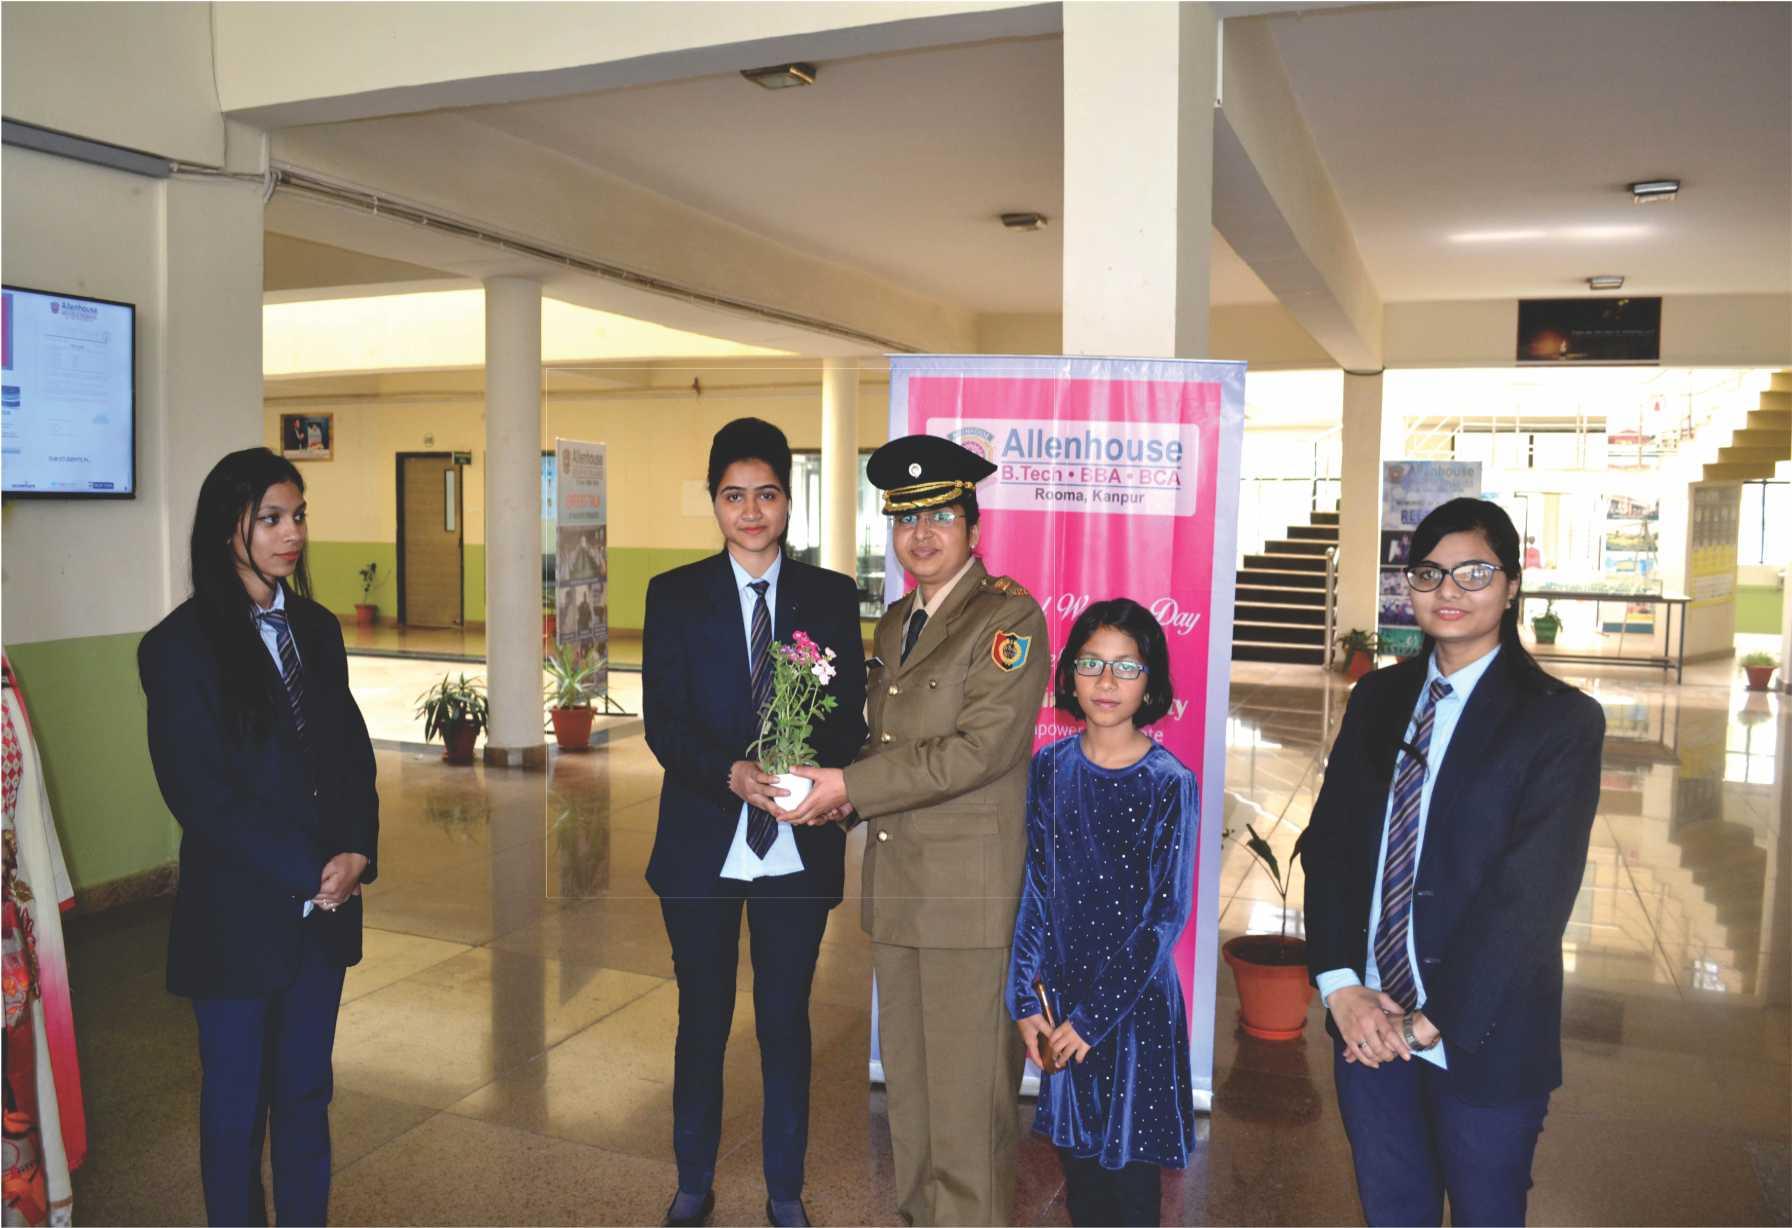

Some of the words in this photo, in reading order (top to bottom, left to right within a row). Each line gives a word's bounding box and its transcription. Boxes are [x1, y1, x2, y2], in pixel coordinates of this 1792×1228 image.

[1002, 428, 1182, 461] Allenhouse
[1002, 464, 1062, 481] B.Tech
[1080, 467, 1121, 483] BBA
[1139, 468, 1181, 485] BCA
[1035, 487, 1087, 502] Rooma,
[1092, 489, 1144, 505] Kanpur
[1151, 597, 1200, 635] Day
